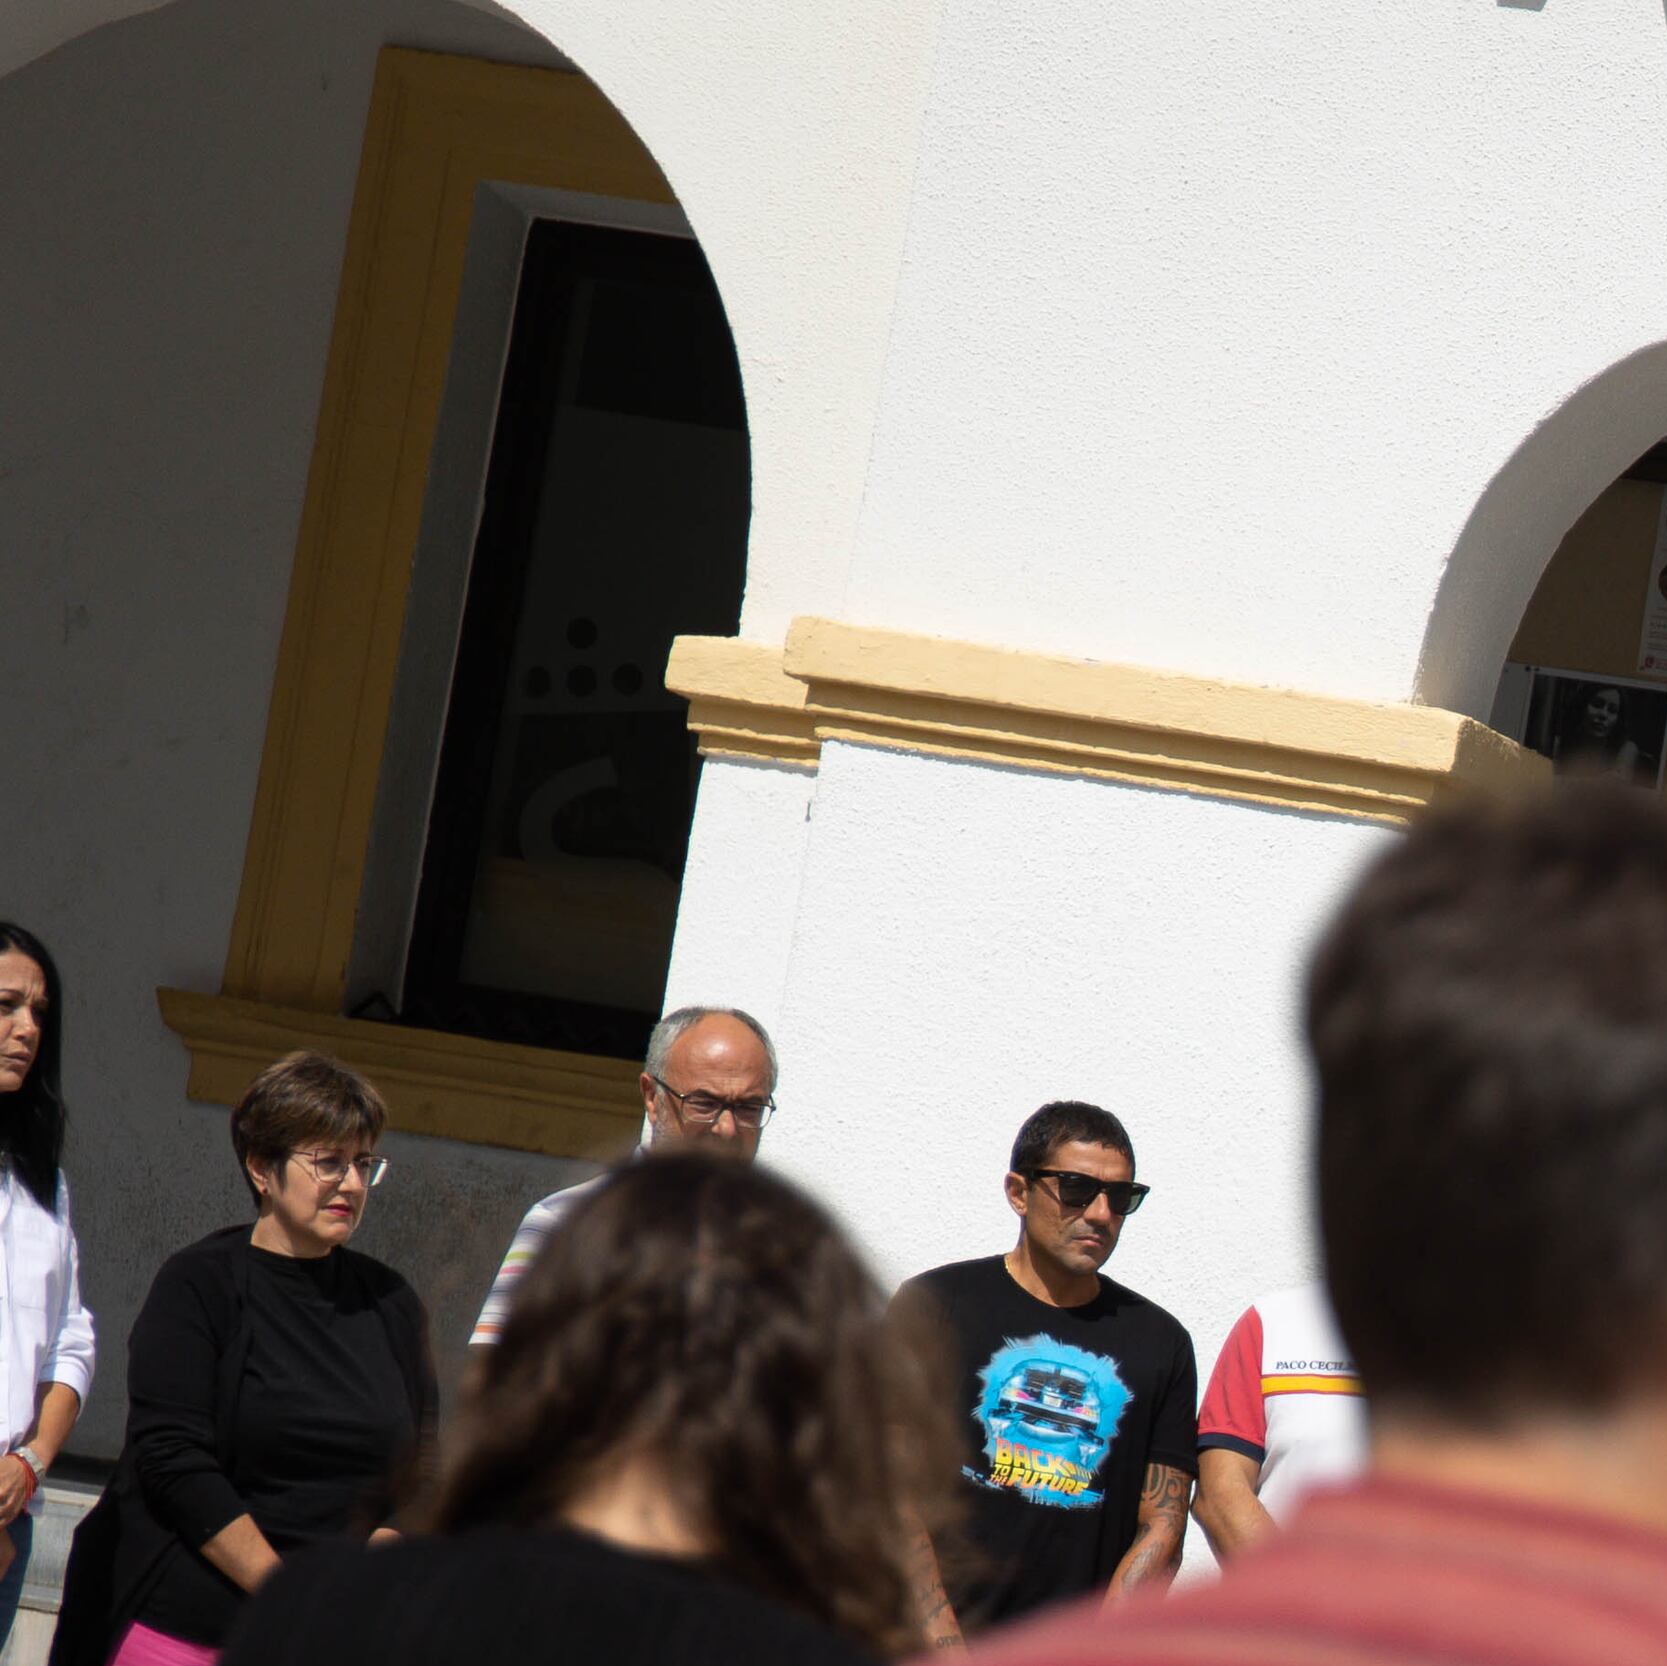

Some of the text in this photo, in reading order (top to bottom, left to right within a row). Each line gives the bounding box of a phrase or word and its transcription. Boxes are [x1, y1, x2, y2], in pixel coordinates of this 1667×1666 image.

[1276, 1360, 1307, 1370] PACO
[995, 1438, 1070, 1476] BACK
[994, 1463, 1010, 1477] TO
[989, 1470, 1089, 1496] THE FUTURE
